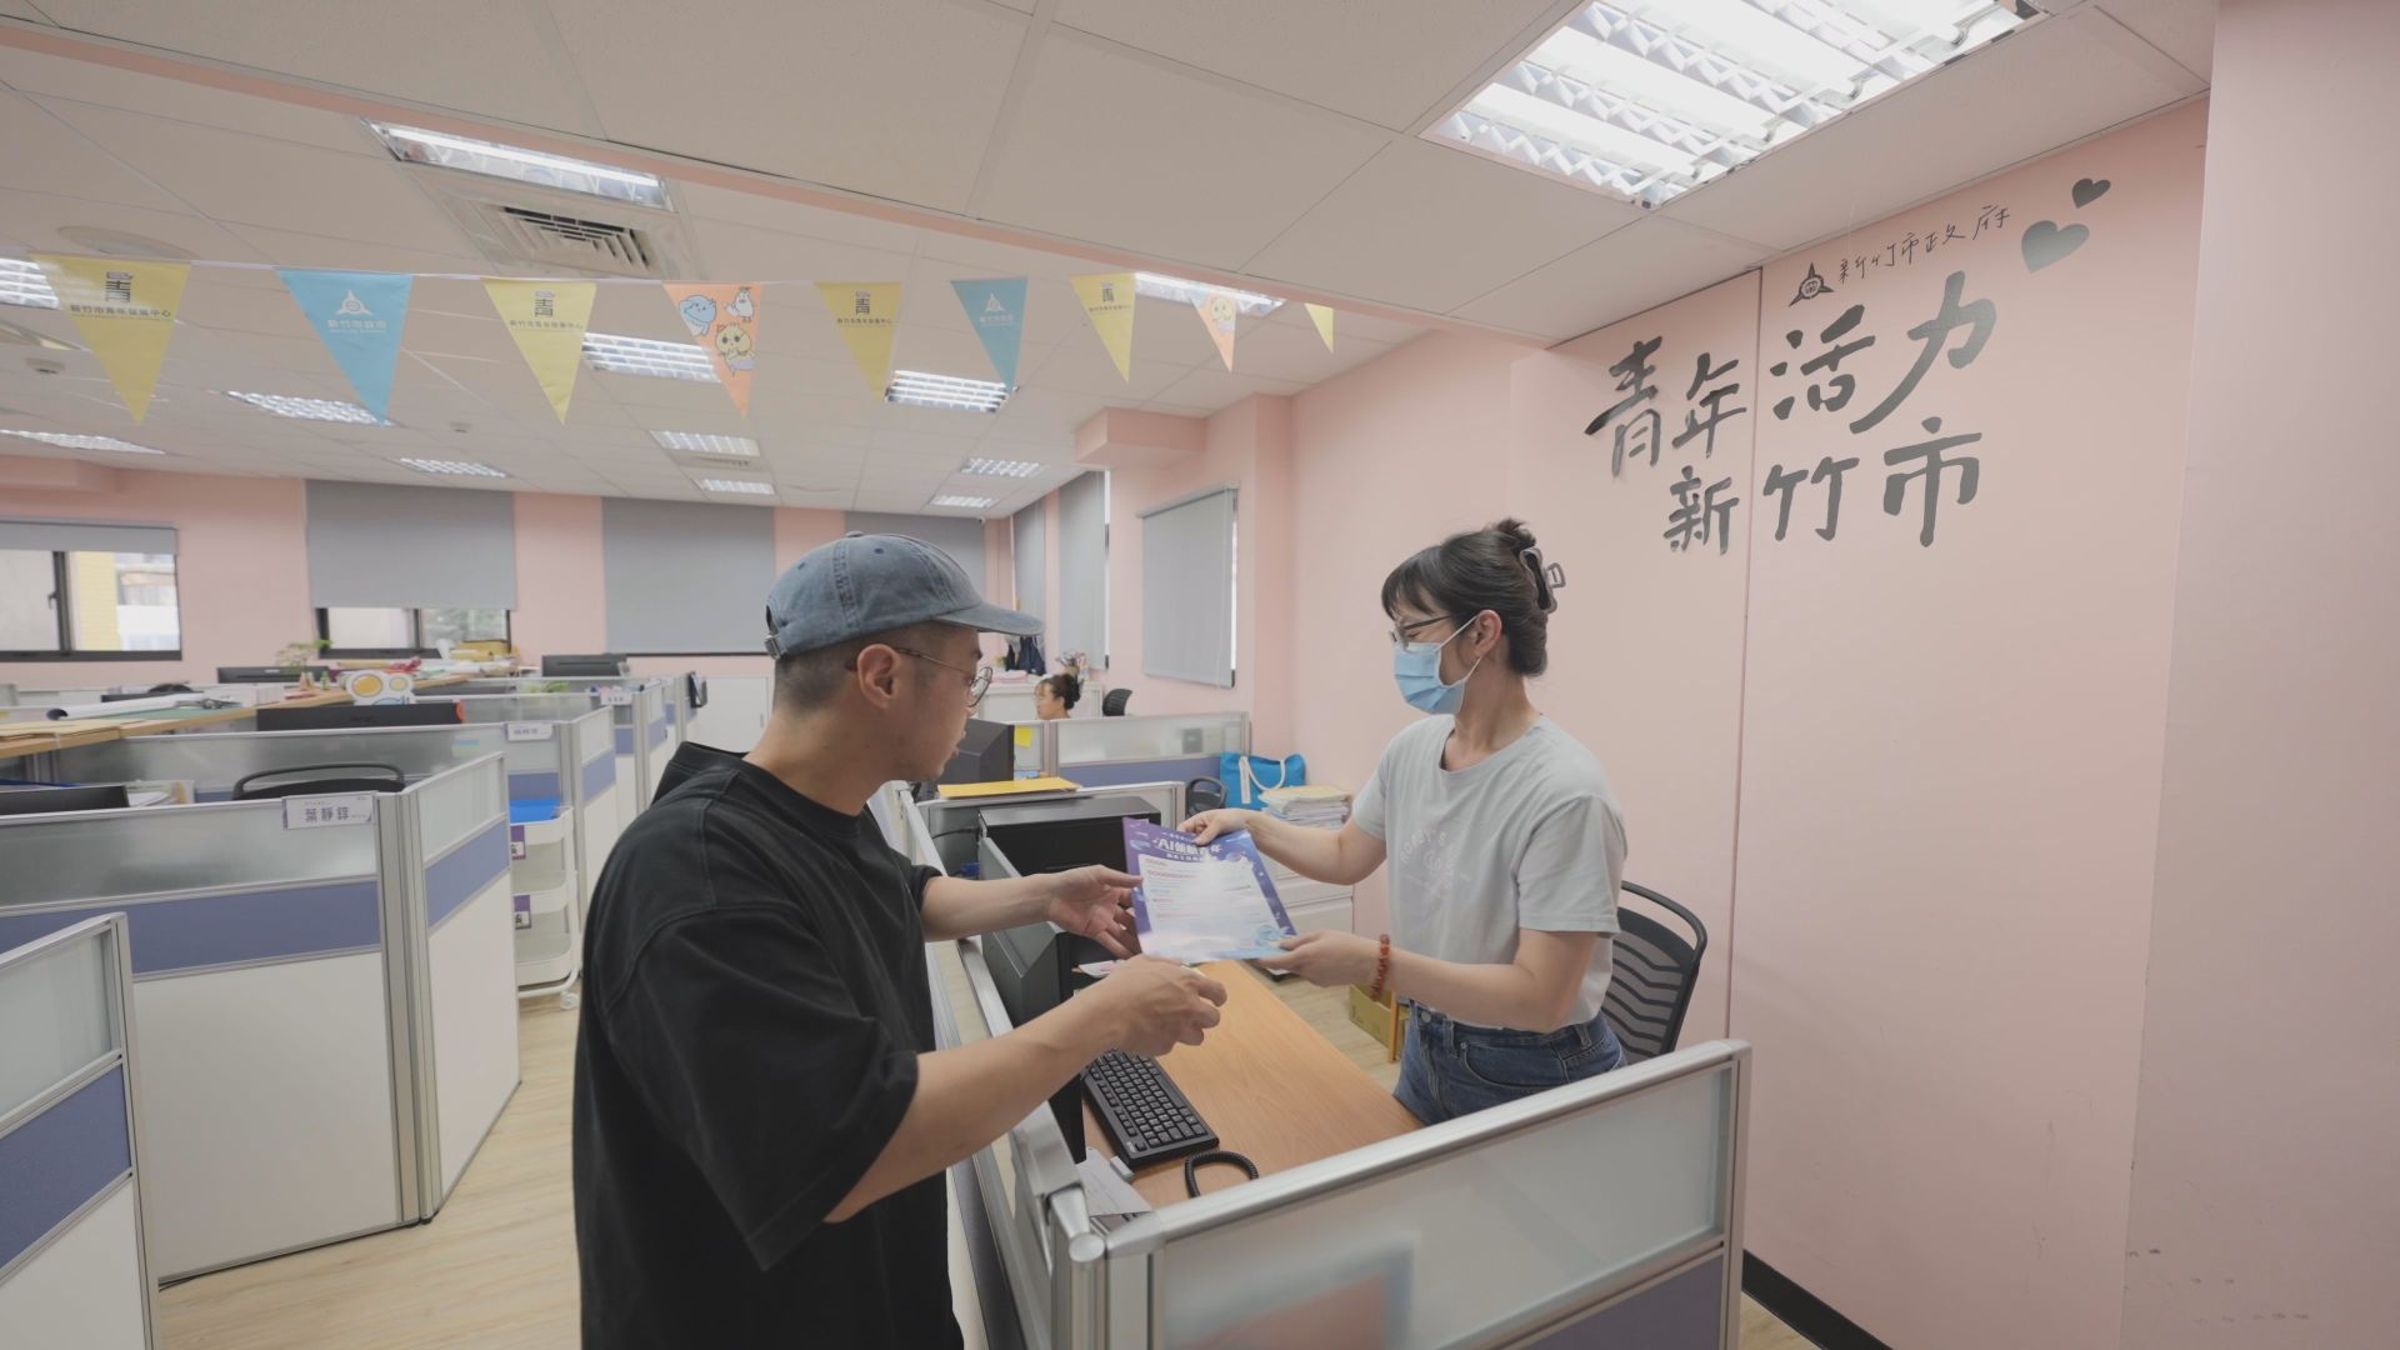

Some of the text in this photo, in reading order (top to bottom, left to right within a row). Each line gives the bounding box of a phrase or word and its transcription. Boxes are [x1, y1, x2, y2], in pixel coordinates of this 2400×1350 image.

[1838, 204, 2011, 284] 新竹市政府
[1663, 416, 1983, 554] 新竹市
